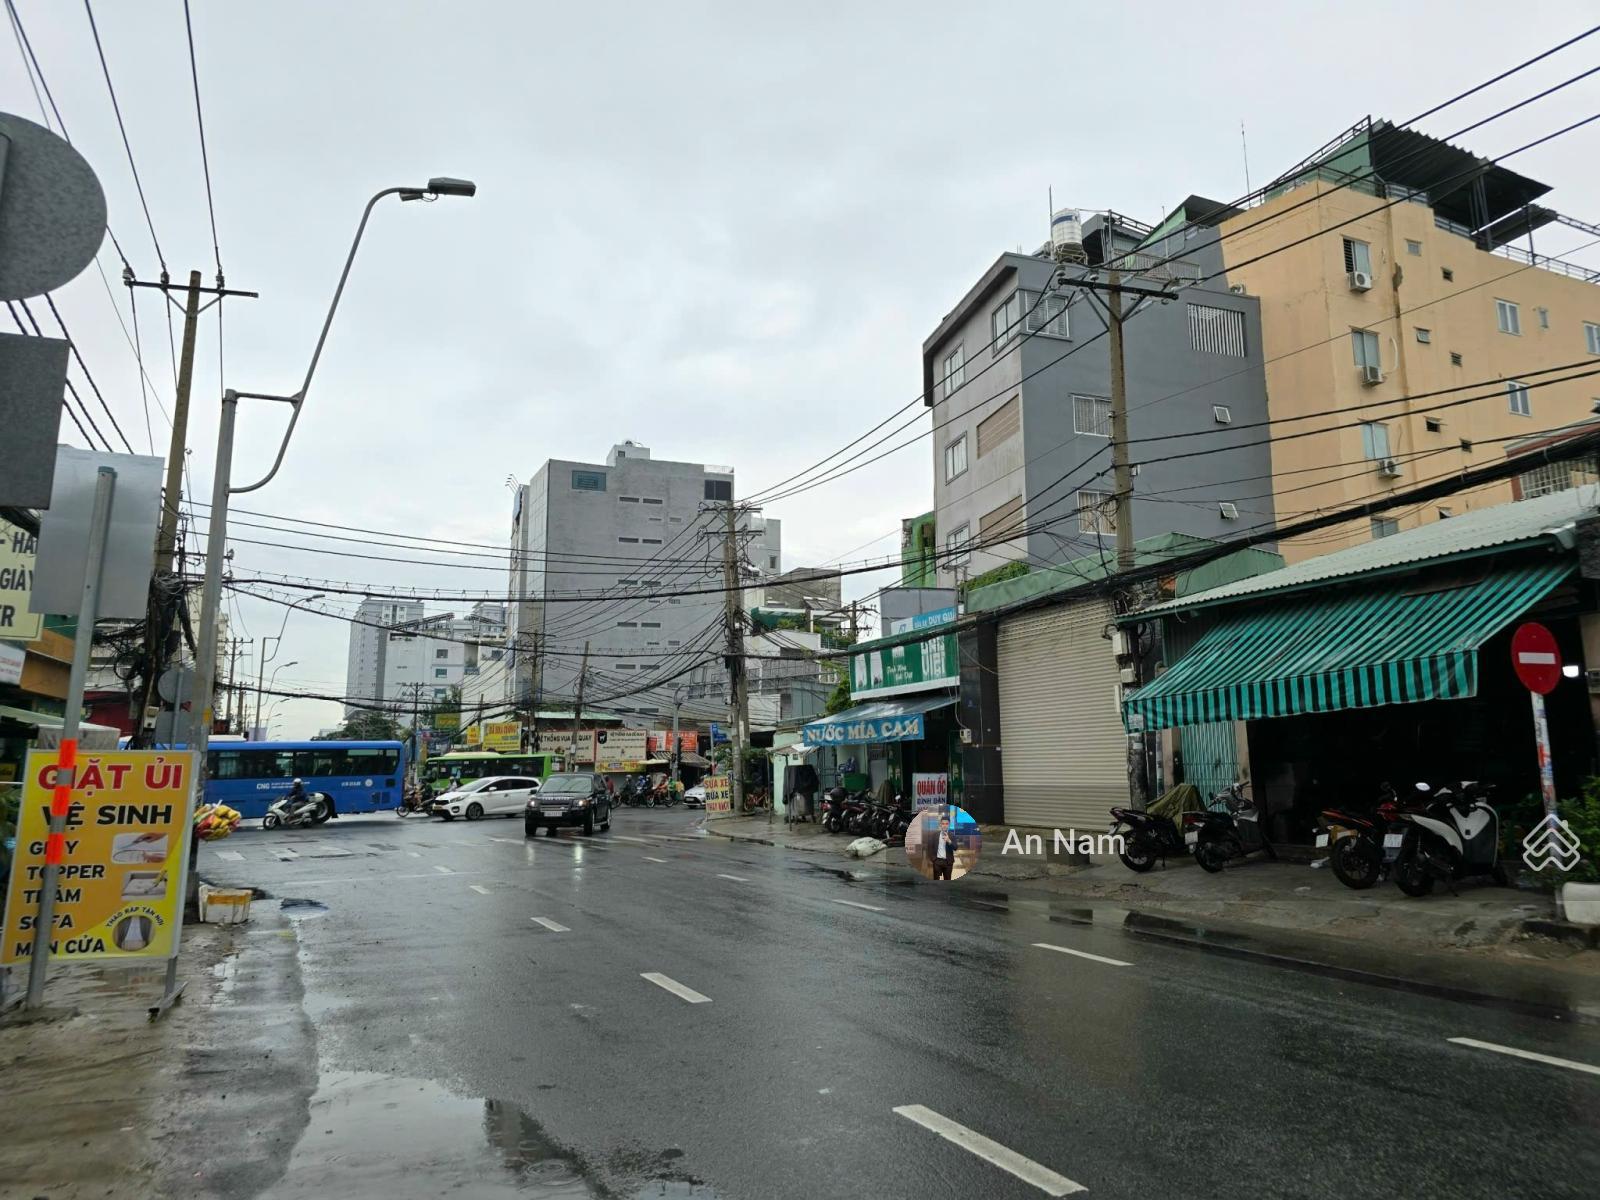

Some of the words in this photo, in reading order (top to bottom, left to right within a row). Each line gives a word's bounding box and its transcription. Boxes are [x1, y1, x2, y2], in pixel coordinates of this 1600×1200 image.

[848, 720, 877, 740] MÍA
[881, 718, 919, 737] CAM
[146, 757, 182, 789] ỦI
[97, 805, 172, 825] SINH
